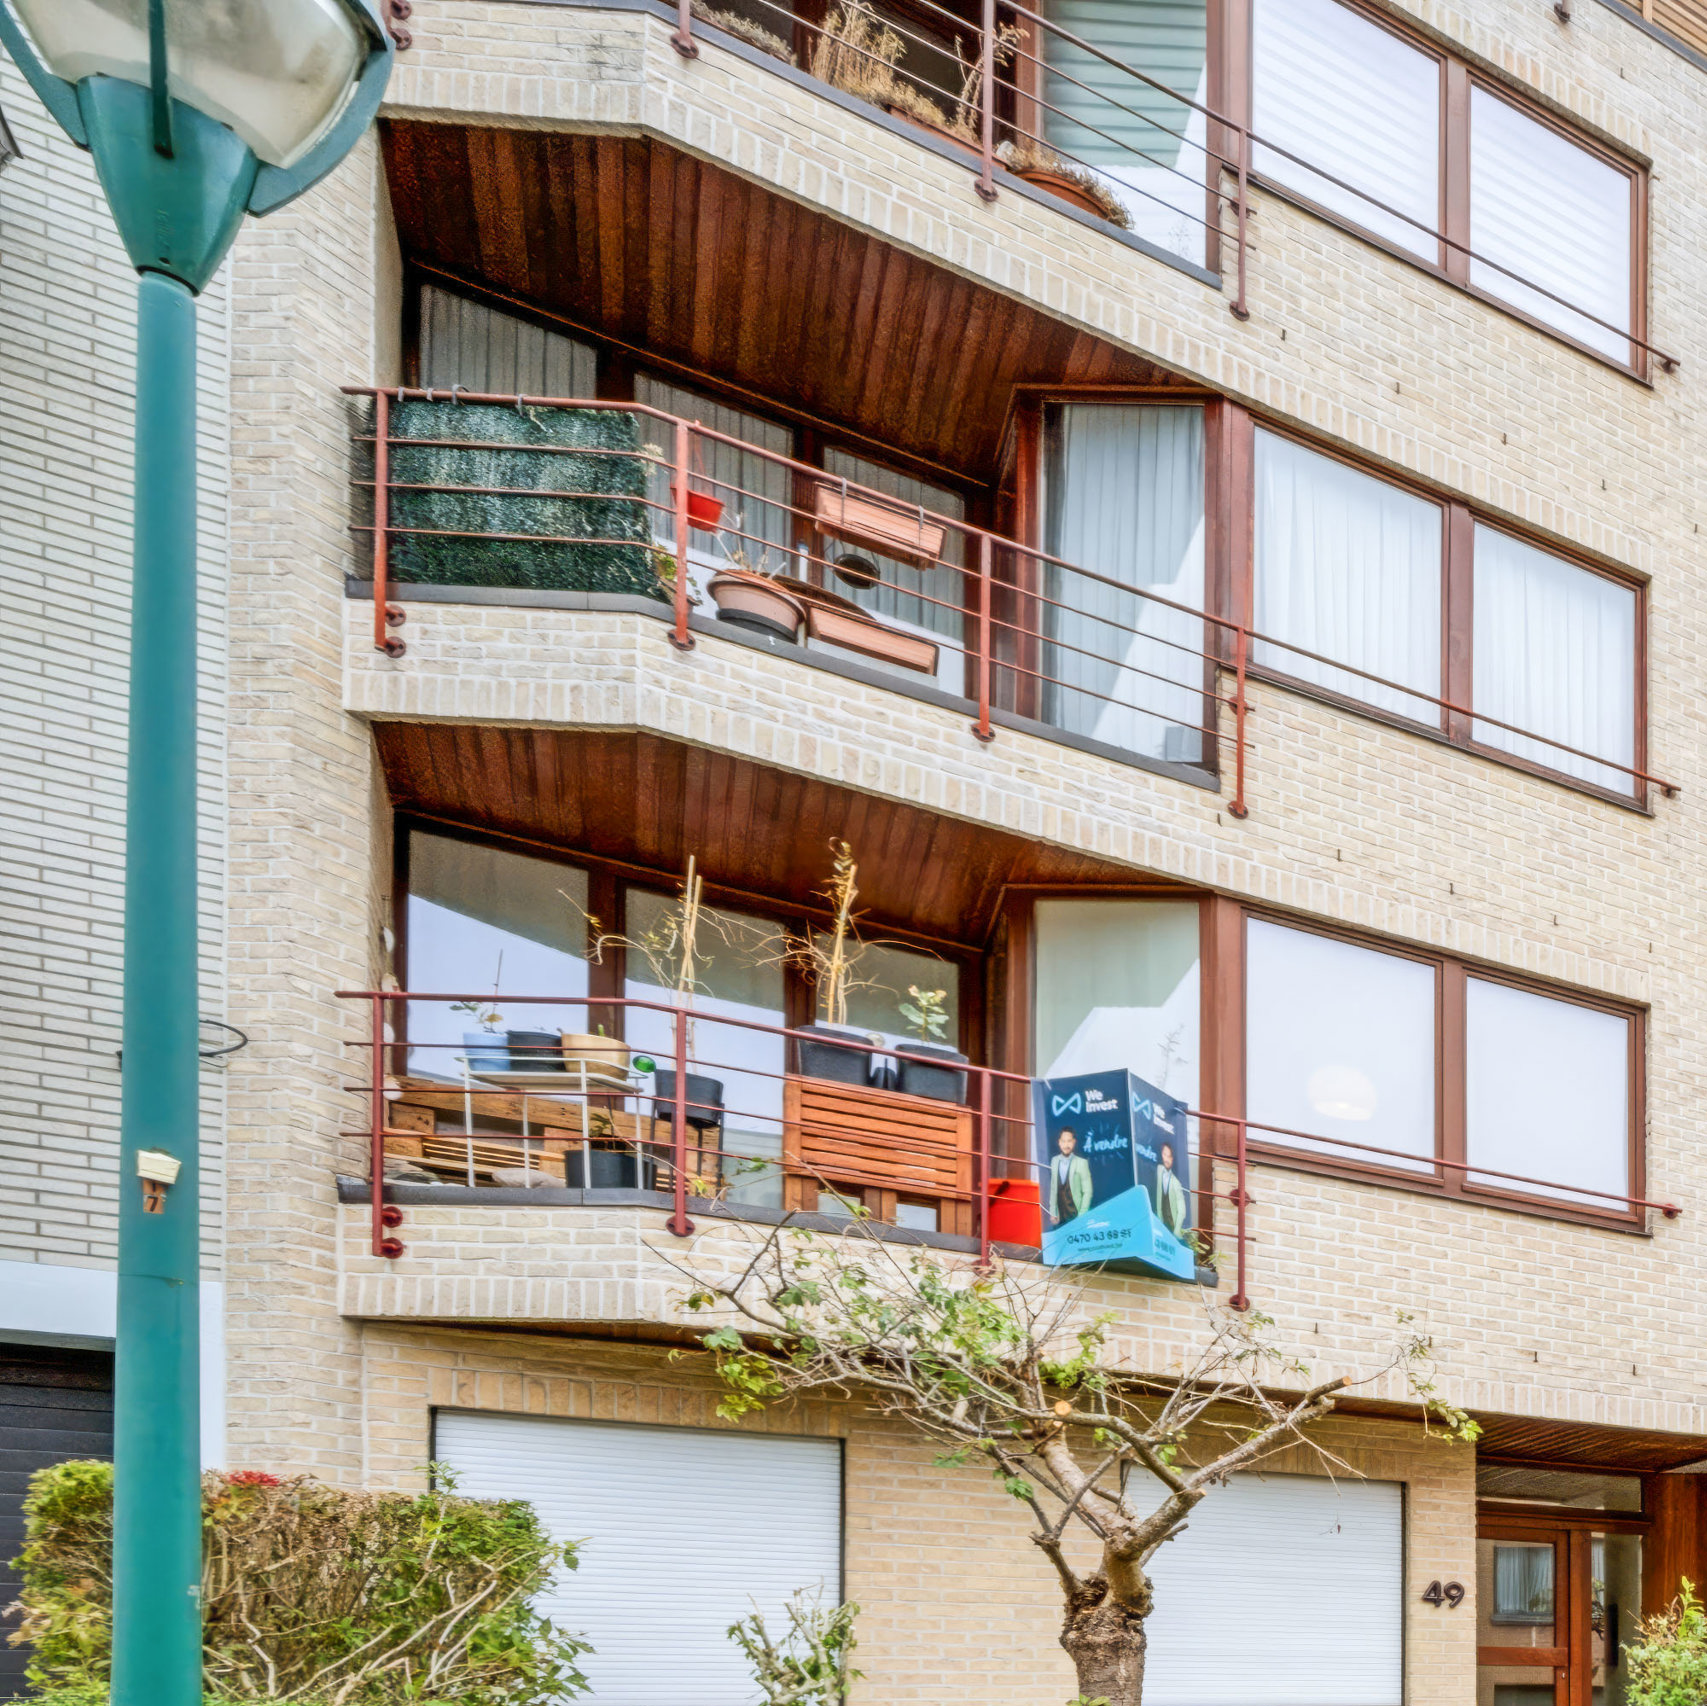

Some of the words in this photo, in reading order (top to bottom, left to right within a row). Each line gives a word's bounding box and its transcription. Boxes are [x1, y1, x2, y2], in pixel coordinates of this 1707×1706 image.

[1085, 1089, 1103, 1101] We
[1085, 1099, 1118, 1113] Invest
[1422, 1580, 1465, 1608] 49
